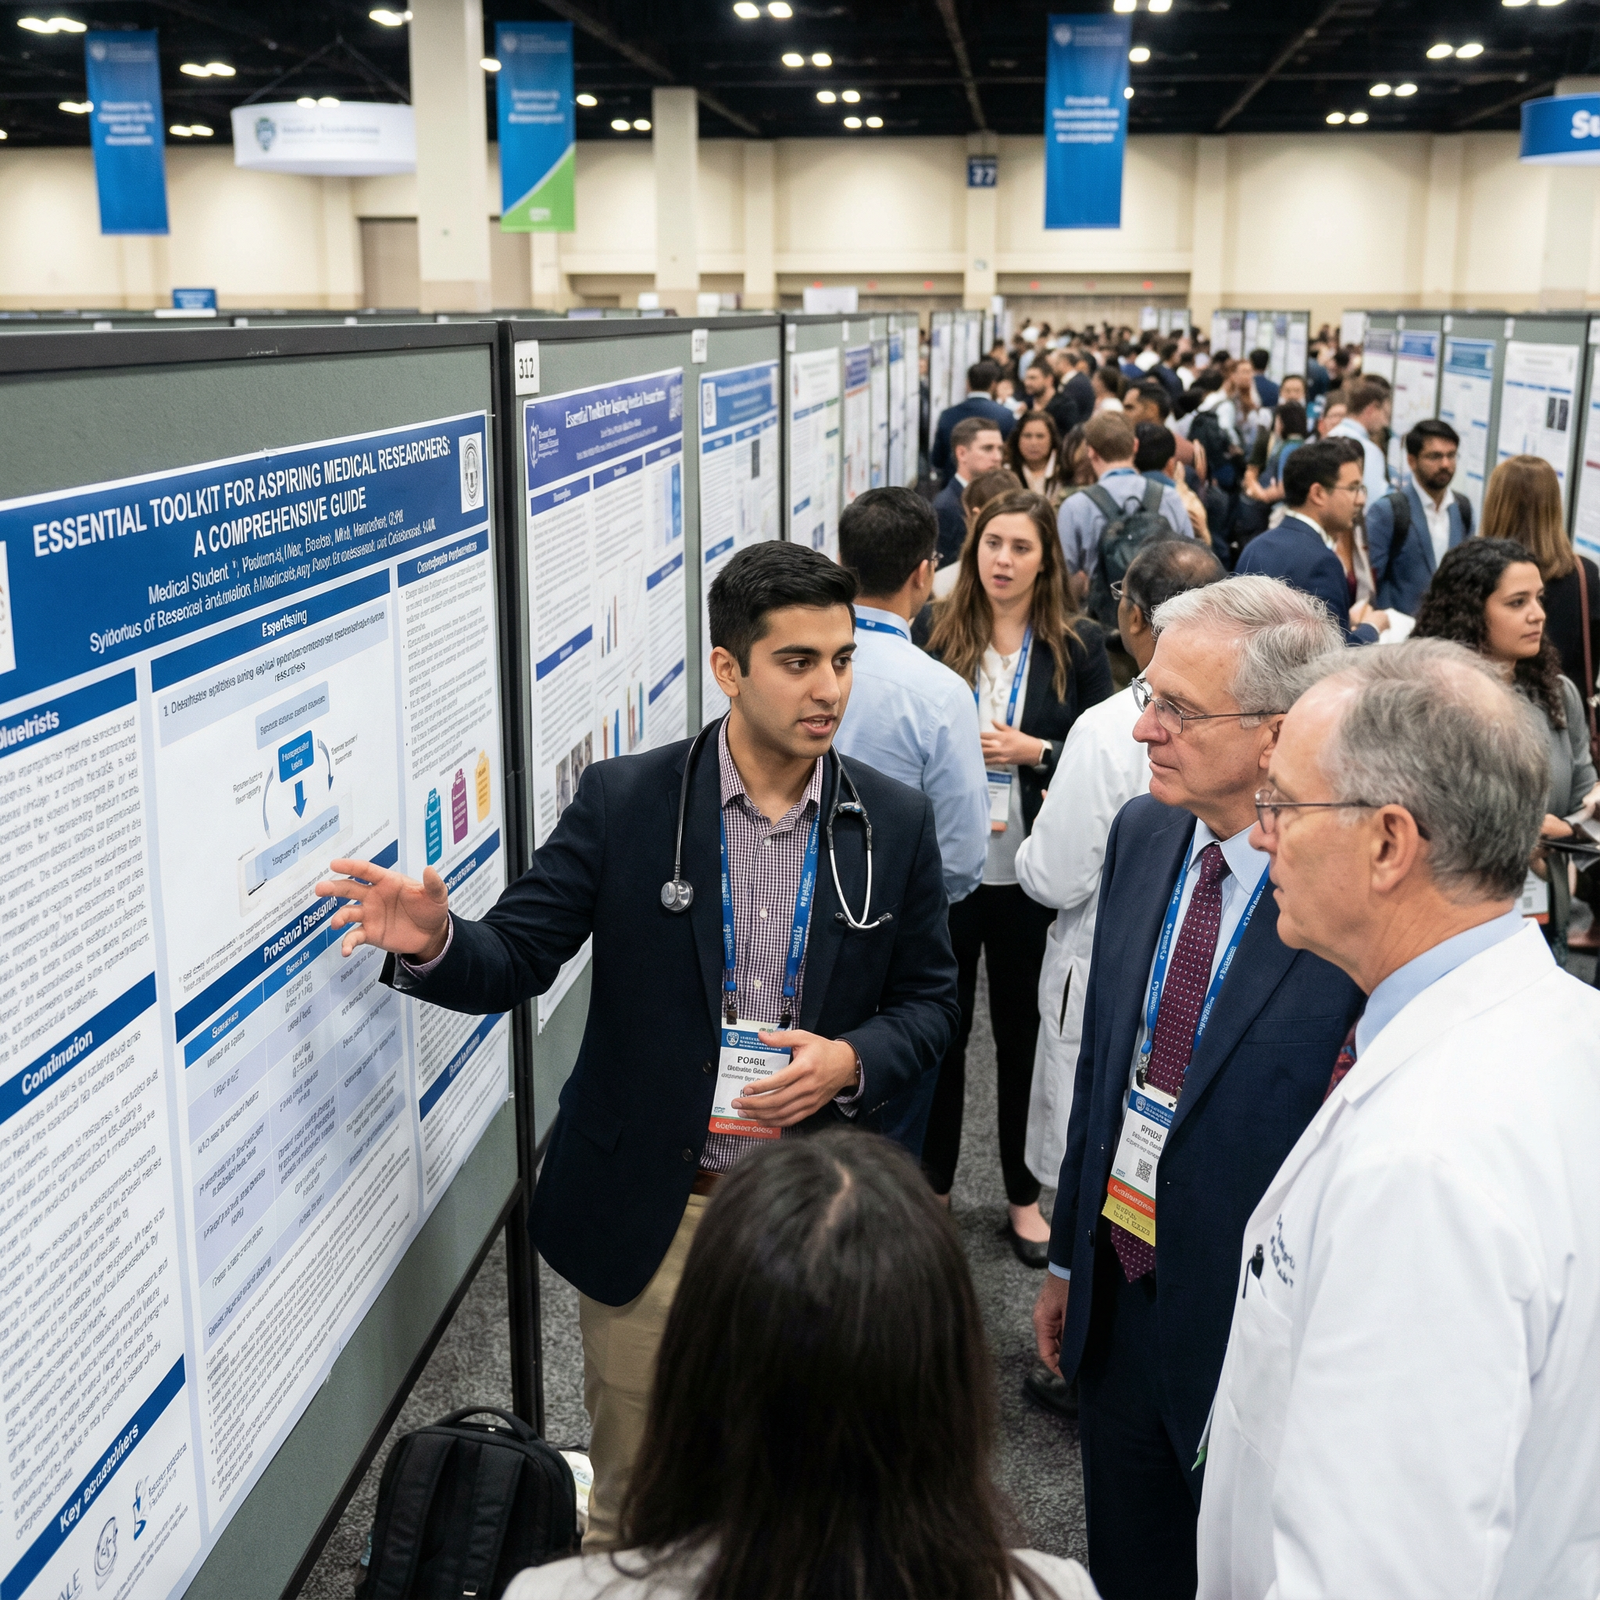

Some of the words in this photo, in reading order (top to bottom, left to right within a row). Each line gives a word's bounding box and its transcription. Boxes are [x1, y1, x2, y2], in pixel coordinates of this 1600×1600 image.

[519, 357, 534, 379] 312
[33, 503, 147, 557] ESSENTIAL
[149, 485, 220, 527] TOOLKIT
[224, 478, 255, 509] FOR
[258, 463, 321, 501] ASPIRING
[324, 452, 377, 487] MEDICAL
[378, 435, 451, 471] RESEARCHERS:
[193, 530, 206, 558] A
[208, 497, 327, 552] COMPREHENSIVE
[330, 486, 366, 518] GUIDE
[148, 575, 190, 605] Medical
[144, 614, 155, 633] of
[60, 1498, 82, 1533] Key
